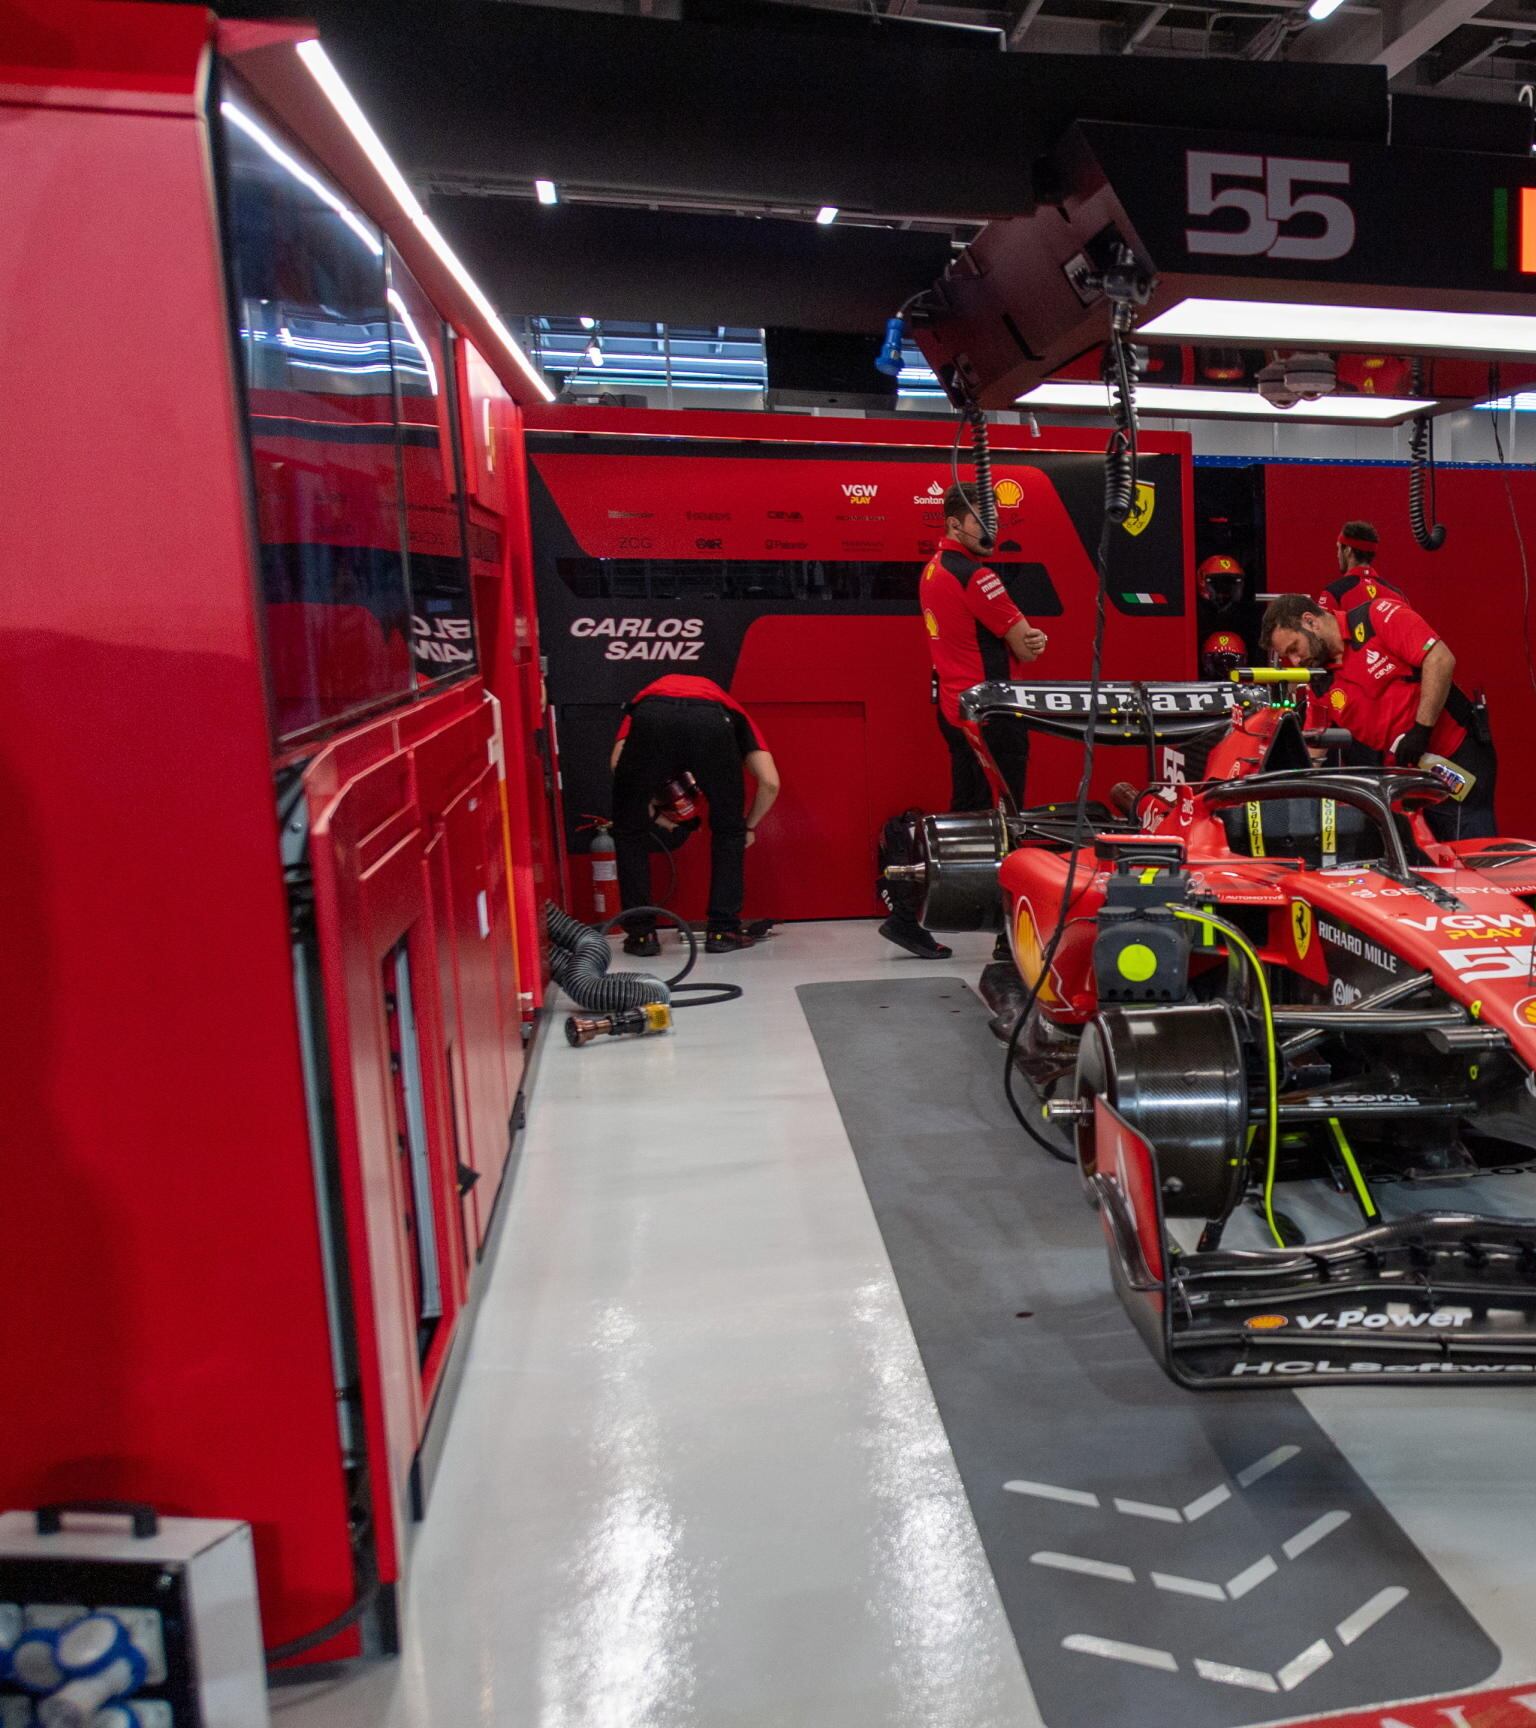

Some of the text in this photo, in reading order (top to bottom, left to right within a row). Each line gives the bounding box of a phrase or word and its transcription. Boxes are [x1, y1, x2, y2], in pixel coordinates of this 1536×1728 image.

[1185, 151, 1355, 262] 55
[841, 484, 878, 497] VGW
[914, 495, 944, 504] Santan
[570, 617, 704, 638] CARLOS
[604, 641, 705, 660] SAINZ
[1009, 685, 1237, 713] Ferrari
[1249, 801, 1262, 856] Sabelt
[1324, 799, 1335, 851] Sabelt
[1395, 913, 1536, 932] VGW
[1445, 927, 1525, 941] PLAY
[1318, 920, 1398, 974] RICHARD MILLE
[1295, 1309, 1473, 1329] V-Power
